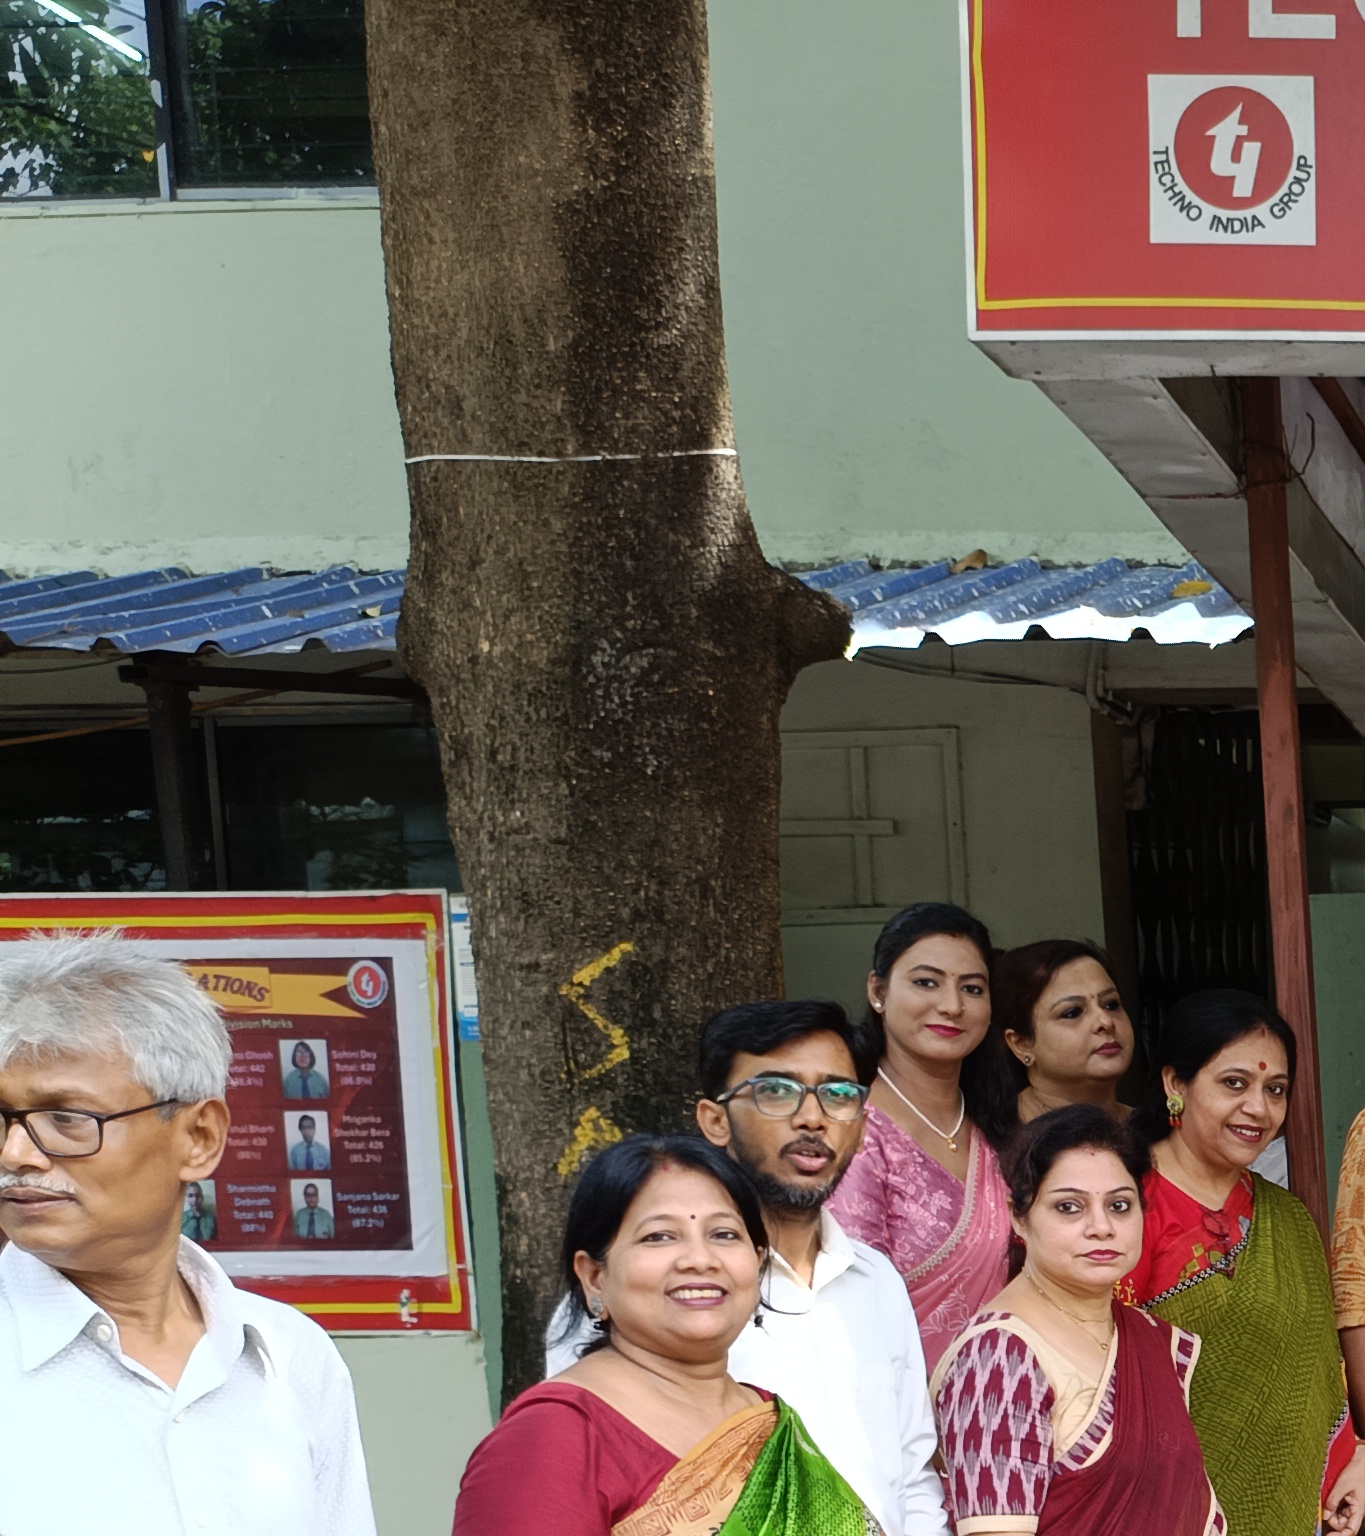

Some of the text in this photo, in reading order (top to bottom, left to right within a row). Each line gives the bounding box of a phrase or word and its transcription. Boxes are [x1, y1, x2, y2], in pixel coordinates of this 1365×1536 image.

[1152, 145, 1314, 235] TECHNO INDIA GROUP
